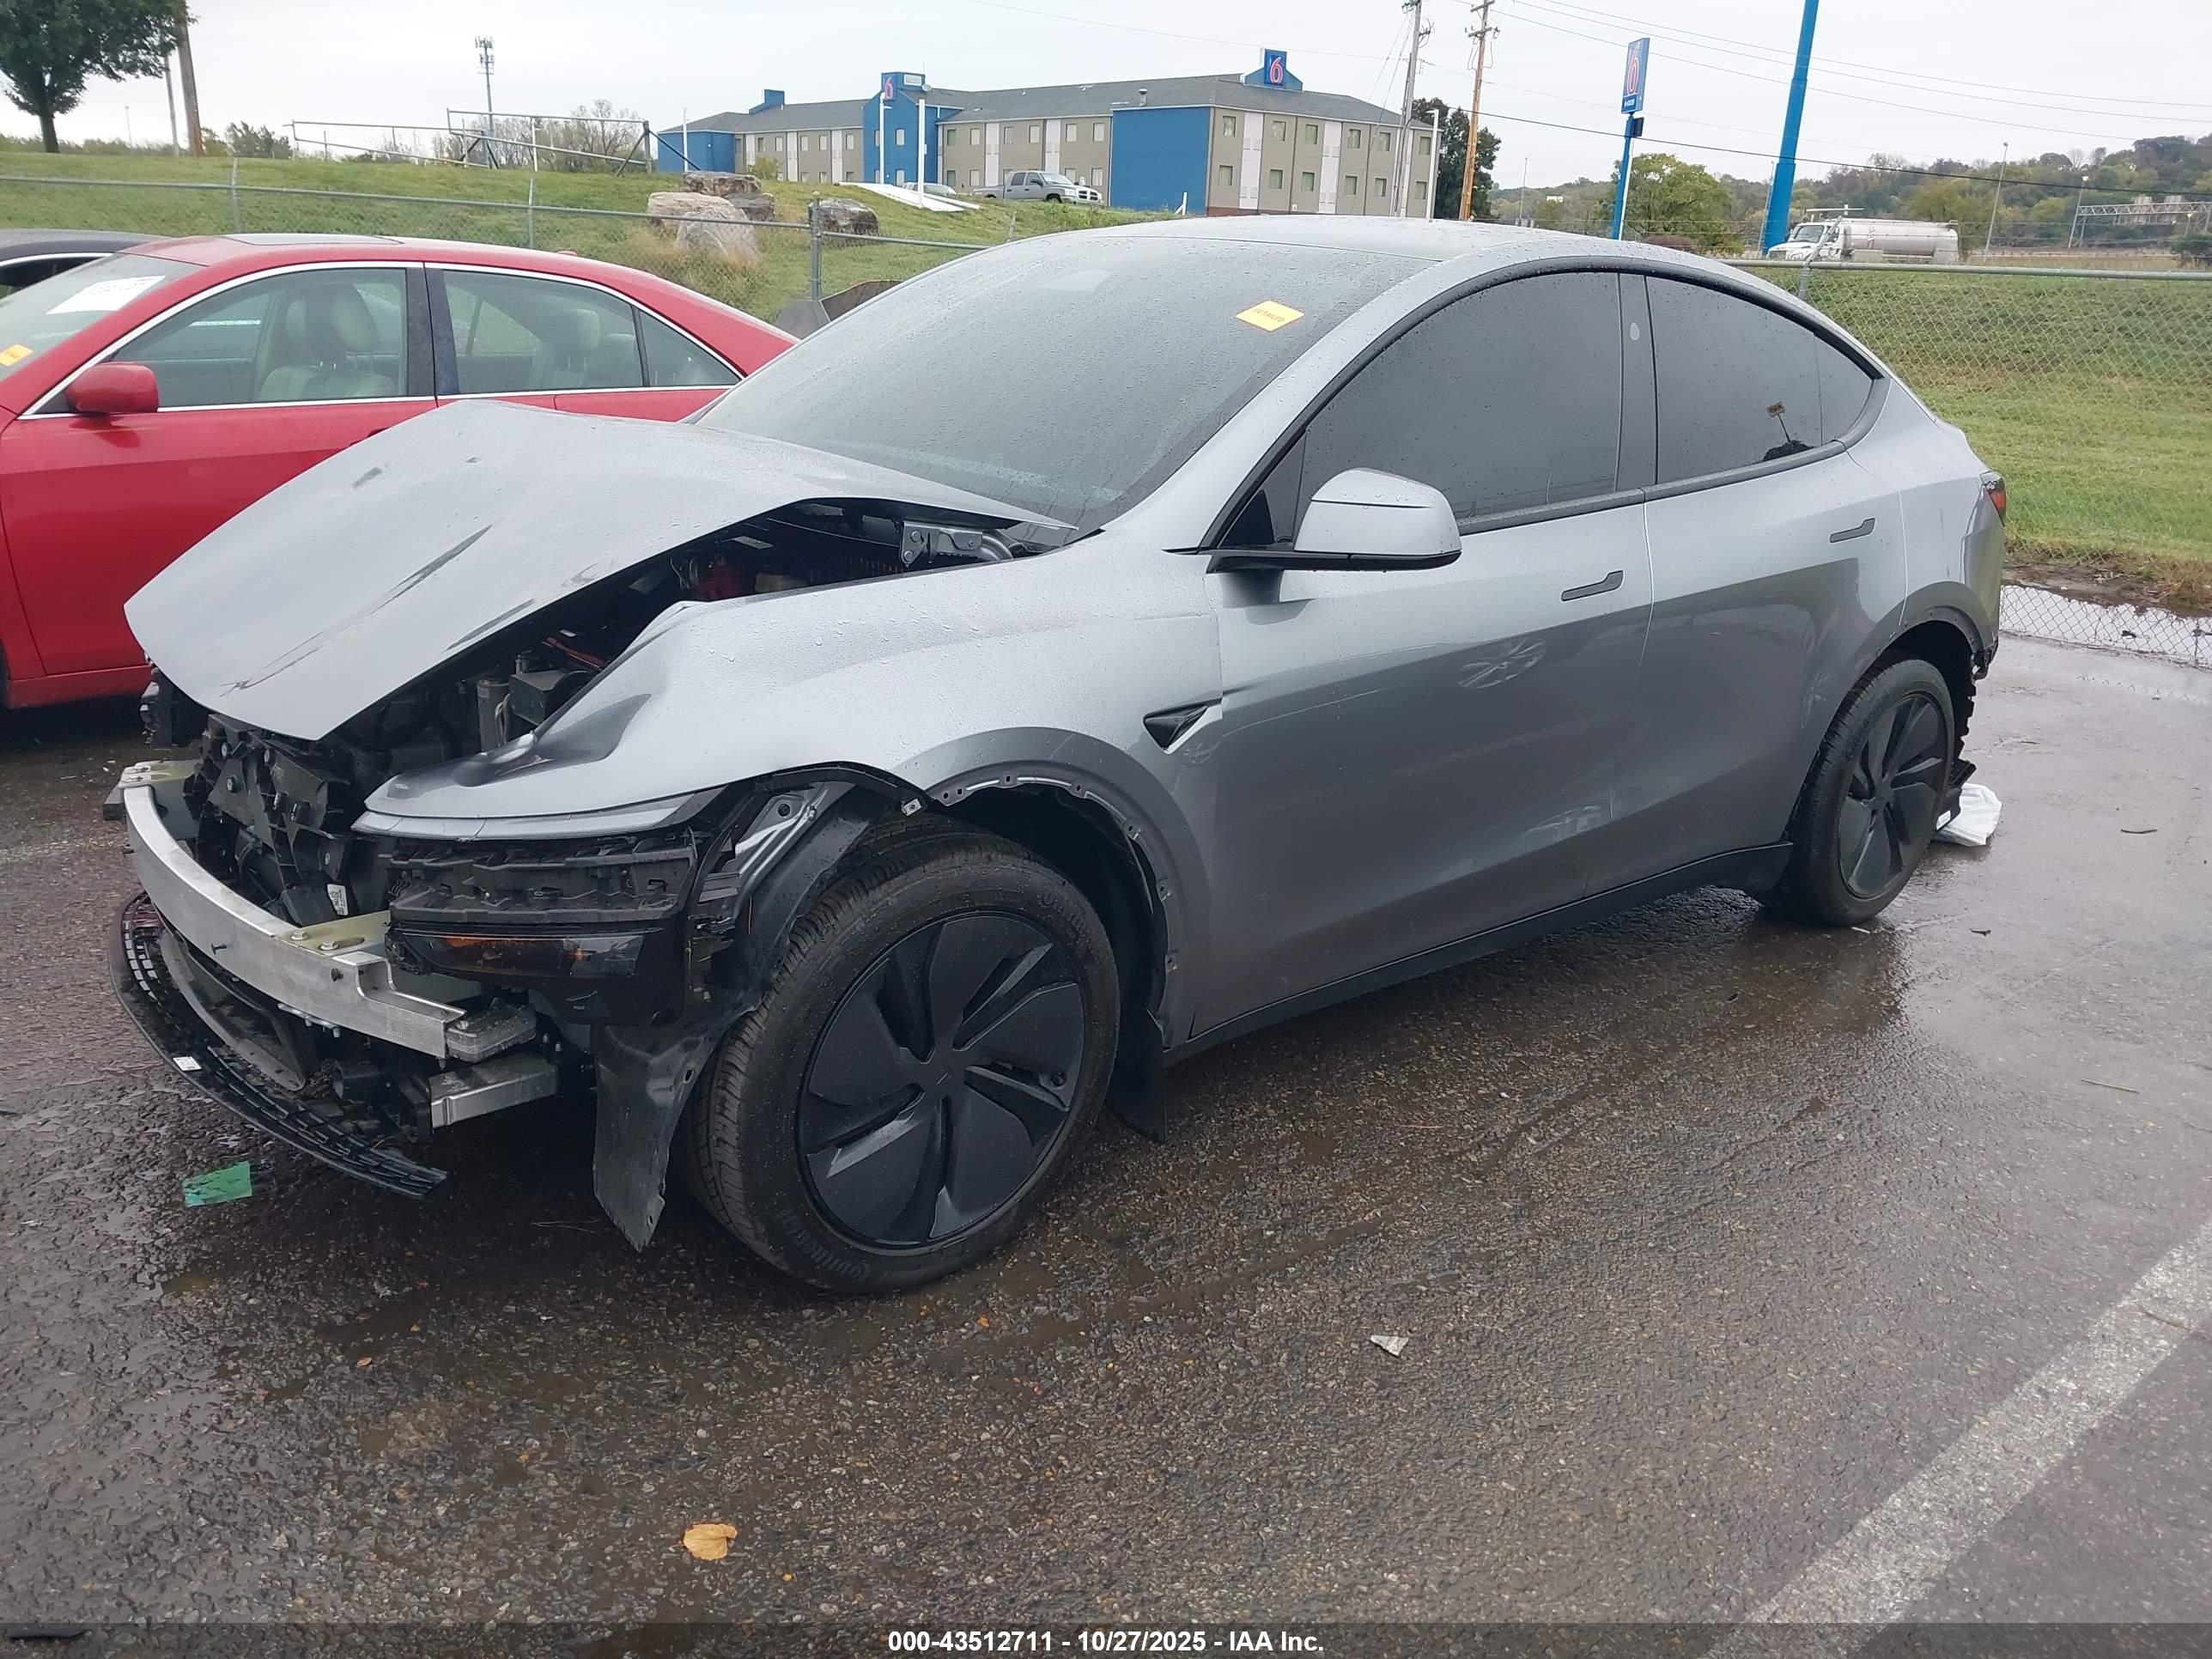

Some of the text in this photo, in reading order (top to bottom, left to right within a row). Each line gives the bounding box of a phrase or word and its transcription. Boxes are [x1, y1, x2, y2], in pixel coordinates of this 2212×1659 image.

[1270, 56, 1283, 83] 6
[1626, 41, 1639, 95] 6
[884, 76, 893, 100] 6
